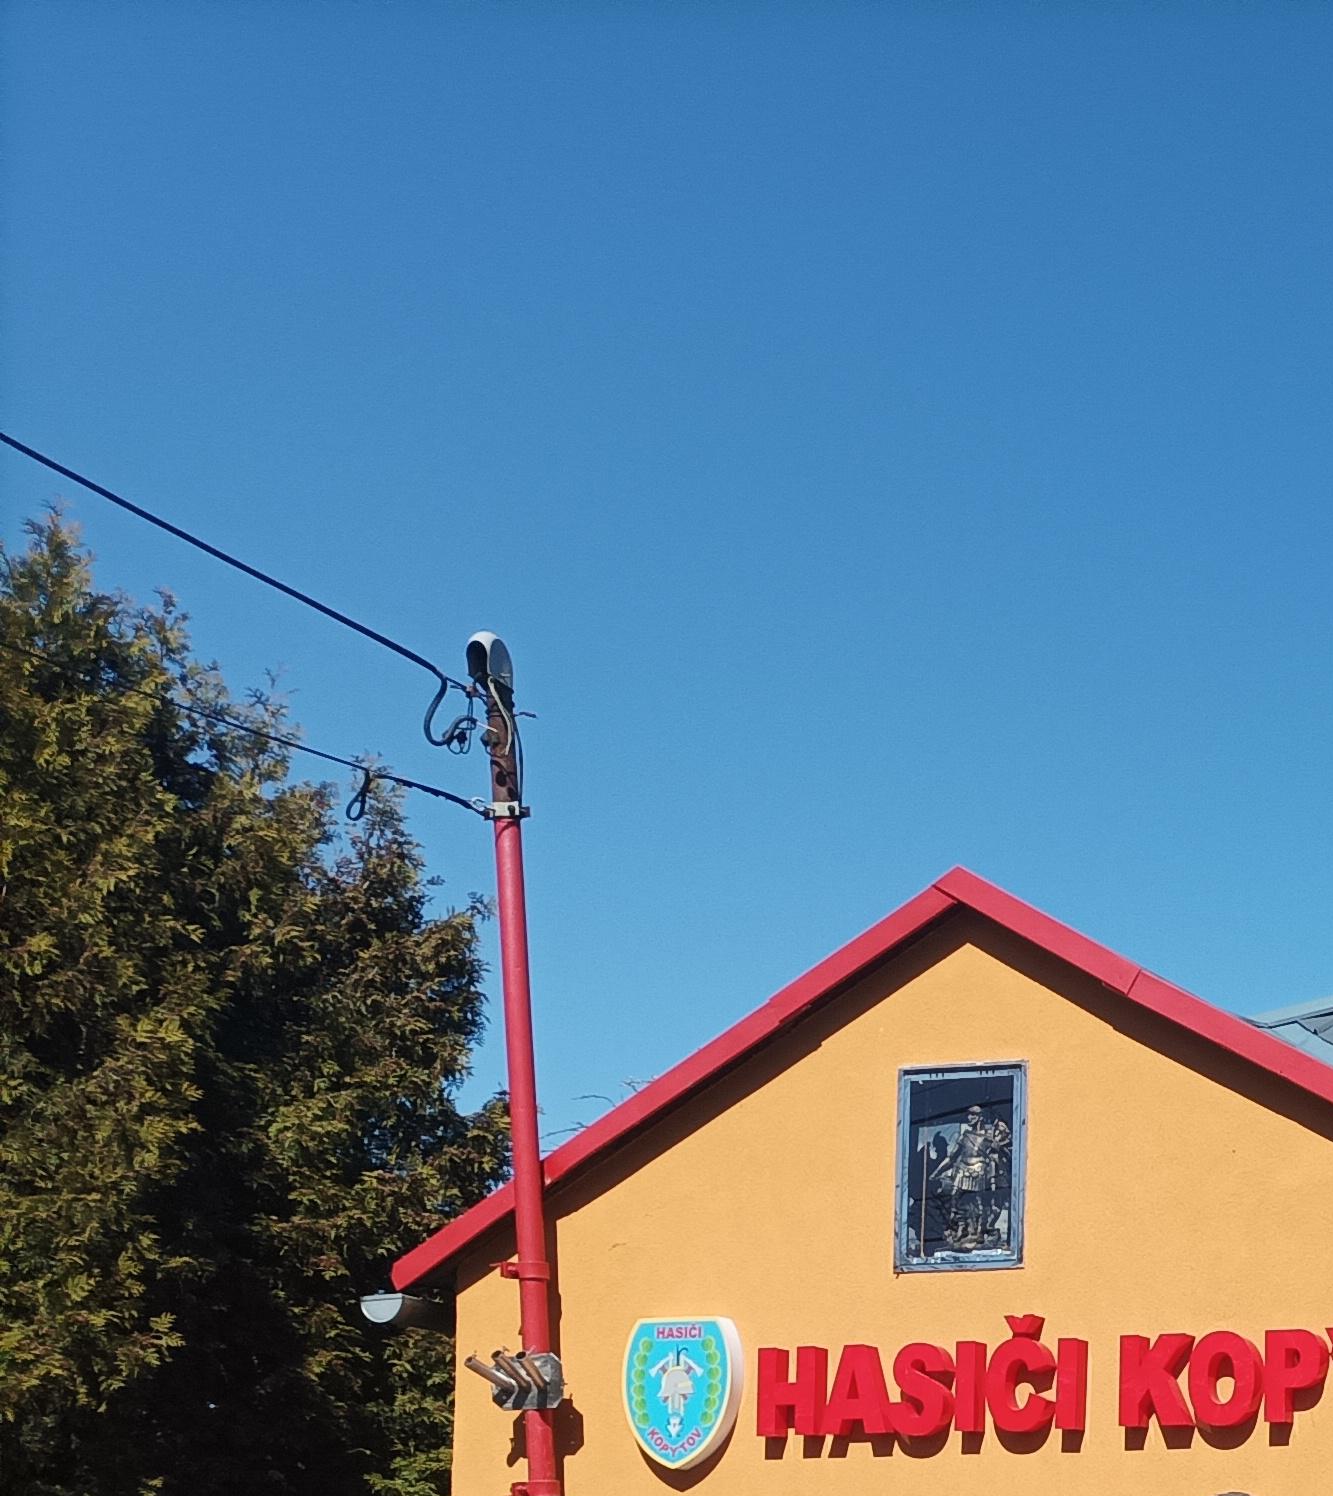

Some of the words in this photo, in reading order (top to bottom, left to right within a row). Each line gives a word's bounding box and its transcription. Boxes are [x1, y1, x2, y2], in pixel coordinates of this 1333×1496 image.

[656, 1324, 702, 1339] HASIČI
[757, 1314, 1088, 1437] HASIČI
[647, 1427, 703, 1457] KOPYTOV
